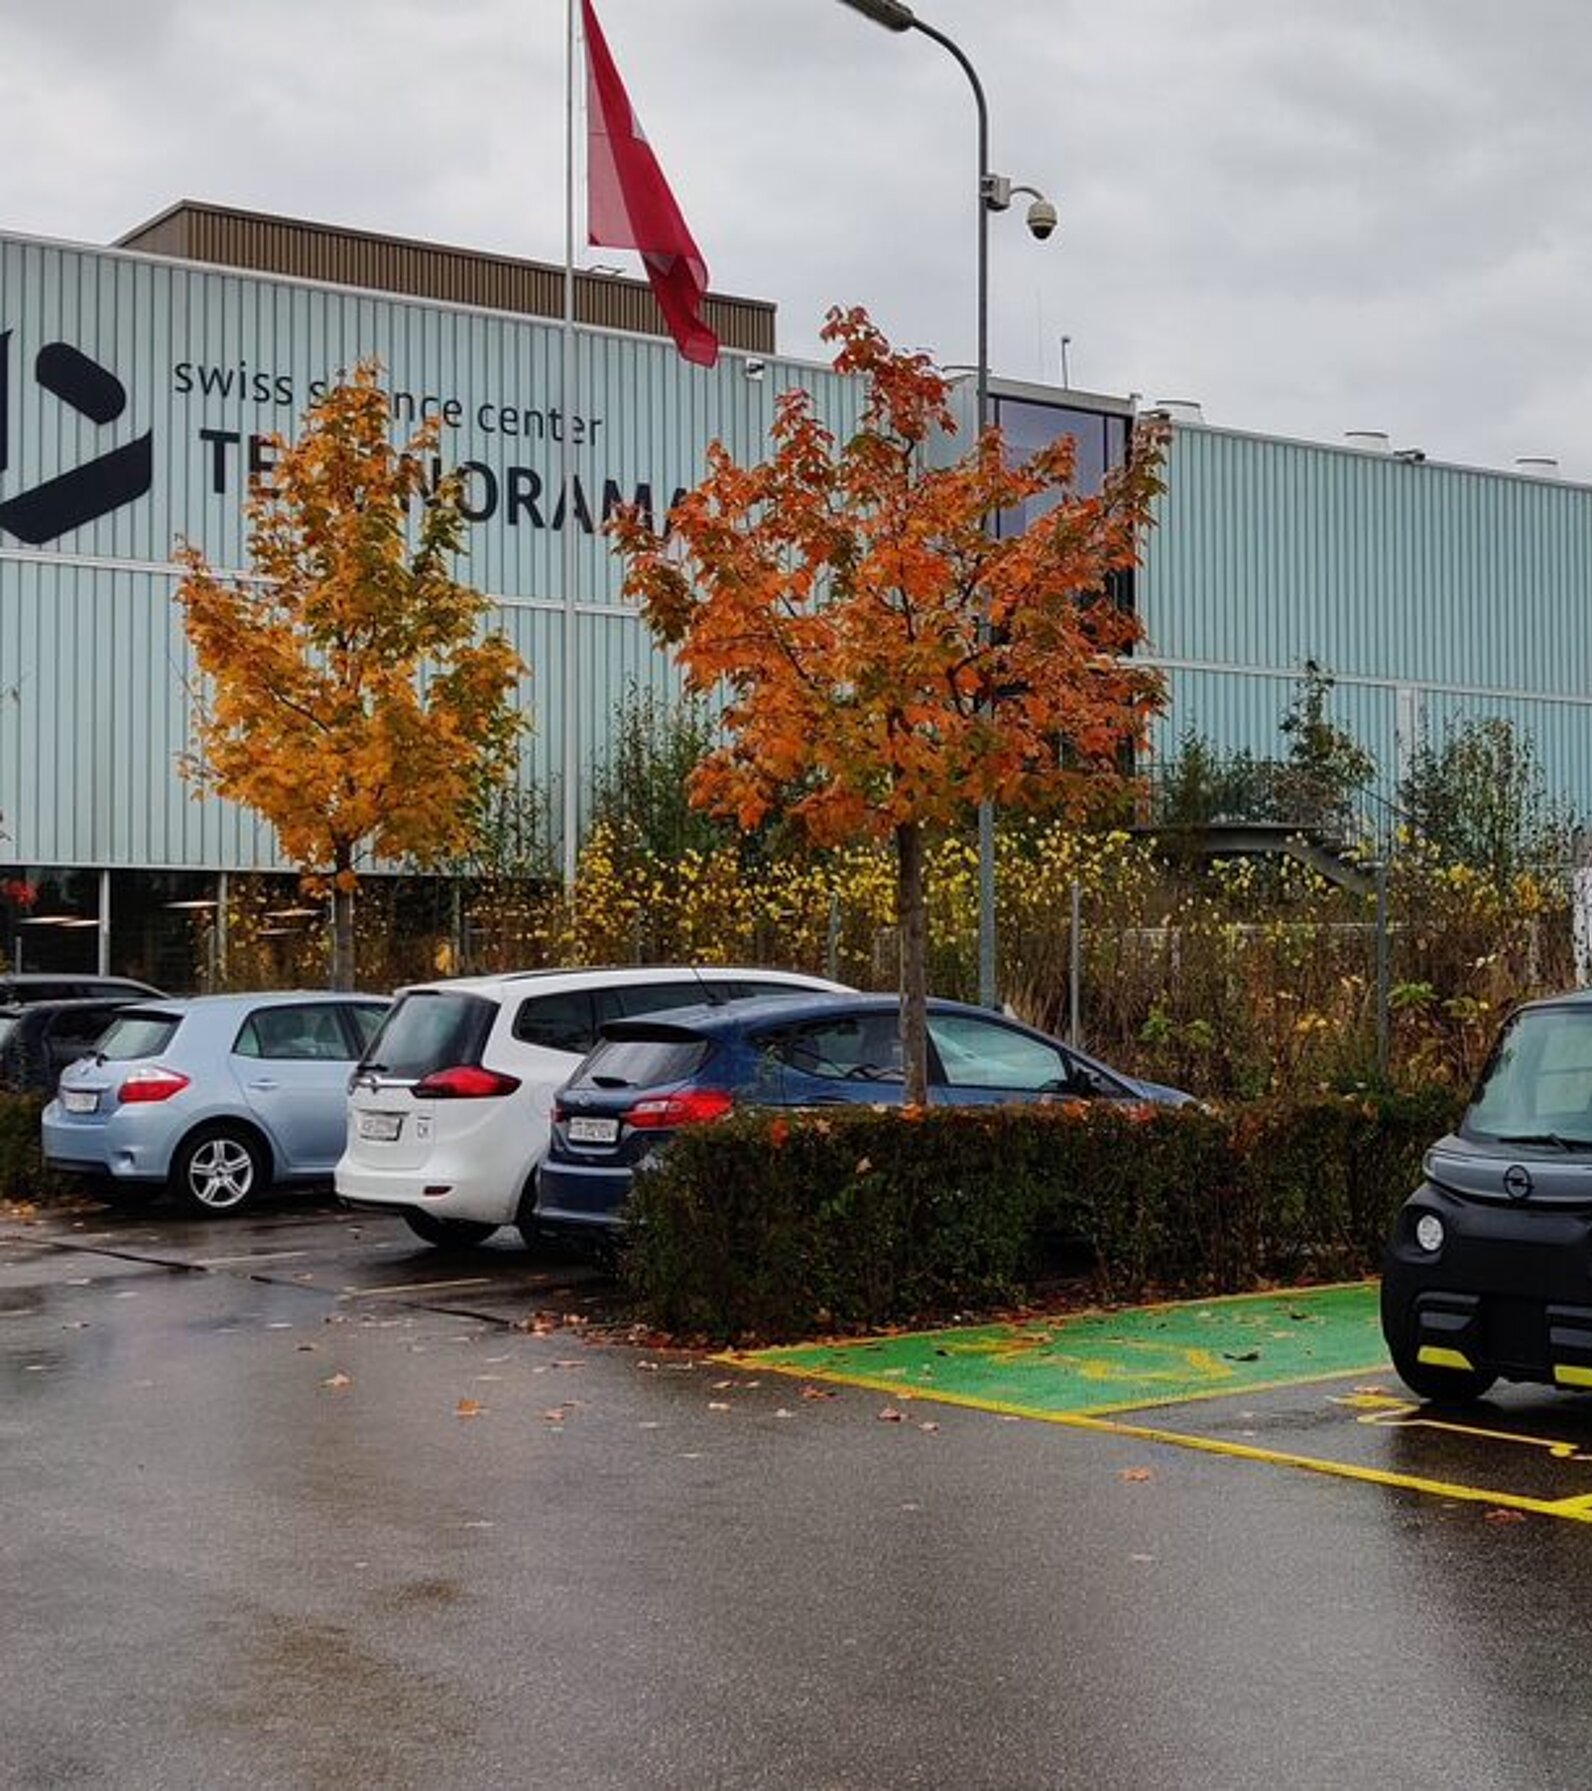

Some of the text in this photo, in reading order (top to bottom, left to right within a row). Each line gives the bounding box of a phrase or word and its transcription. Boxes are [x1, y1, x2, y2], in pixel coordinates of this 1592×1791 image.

[174, 360, 603, 446] swiss snce center
